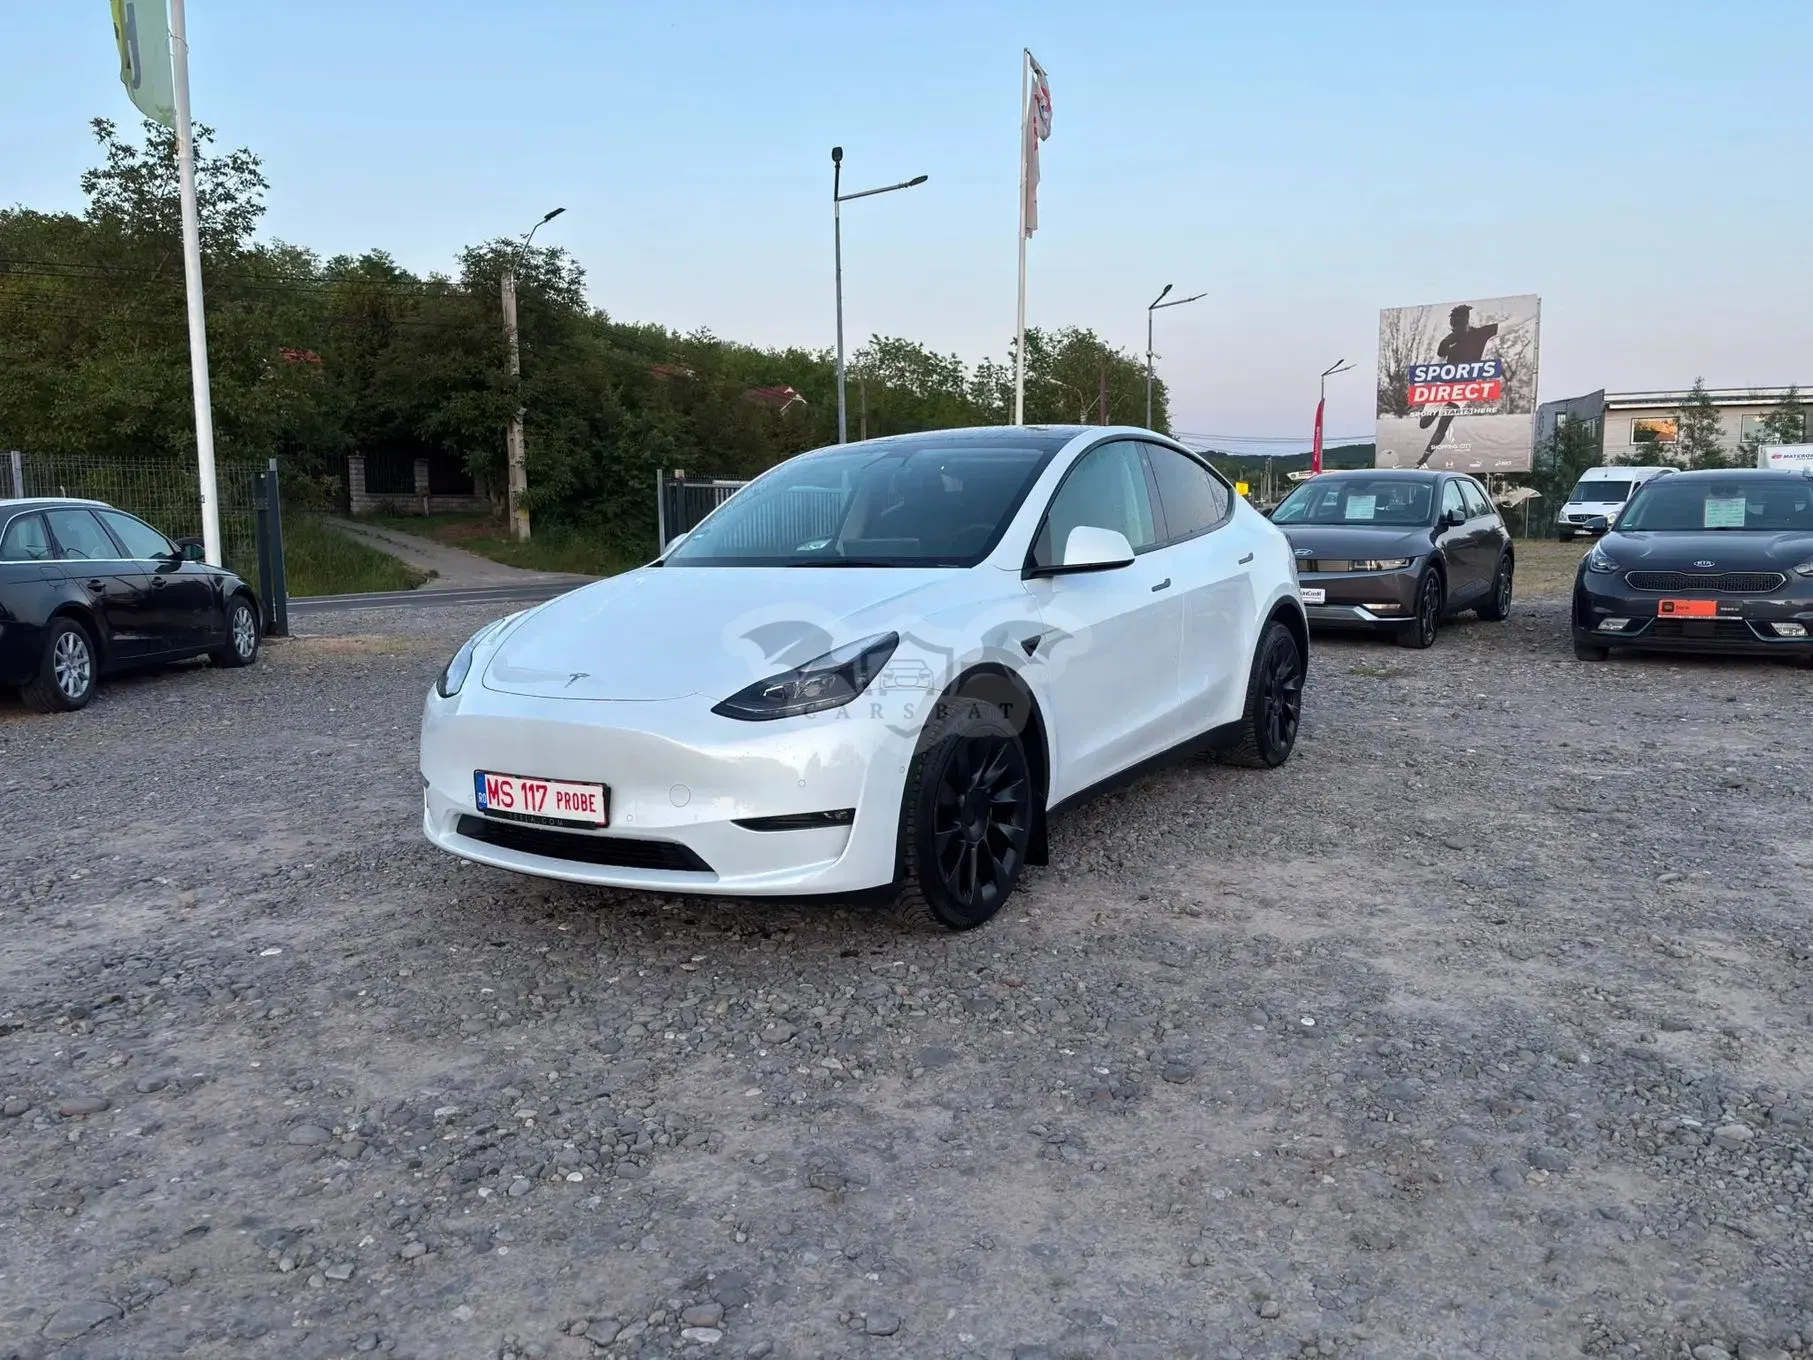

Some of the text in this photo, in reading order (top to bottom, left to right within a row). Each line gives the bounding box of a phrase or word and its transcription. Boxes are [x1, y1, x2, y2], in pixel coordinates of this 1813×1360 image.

[1414, 362, 1496, 382] SPORTS
[1413, 383, 1494, 402] DIRECT
[478, 792, 487, 804] RO
[487, 778, 597, 813] MS 117 PROBE
